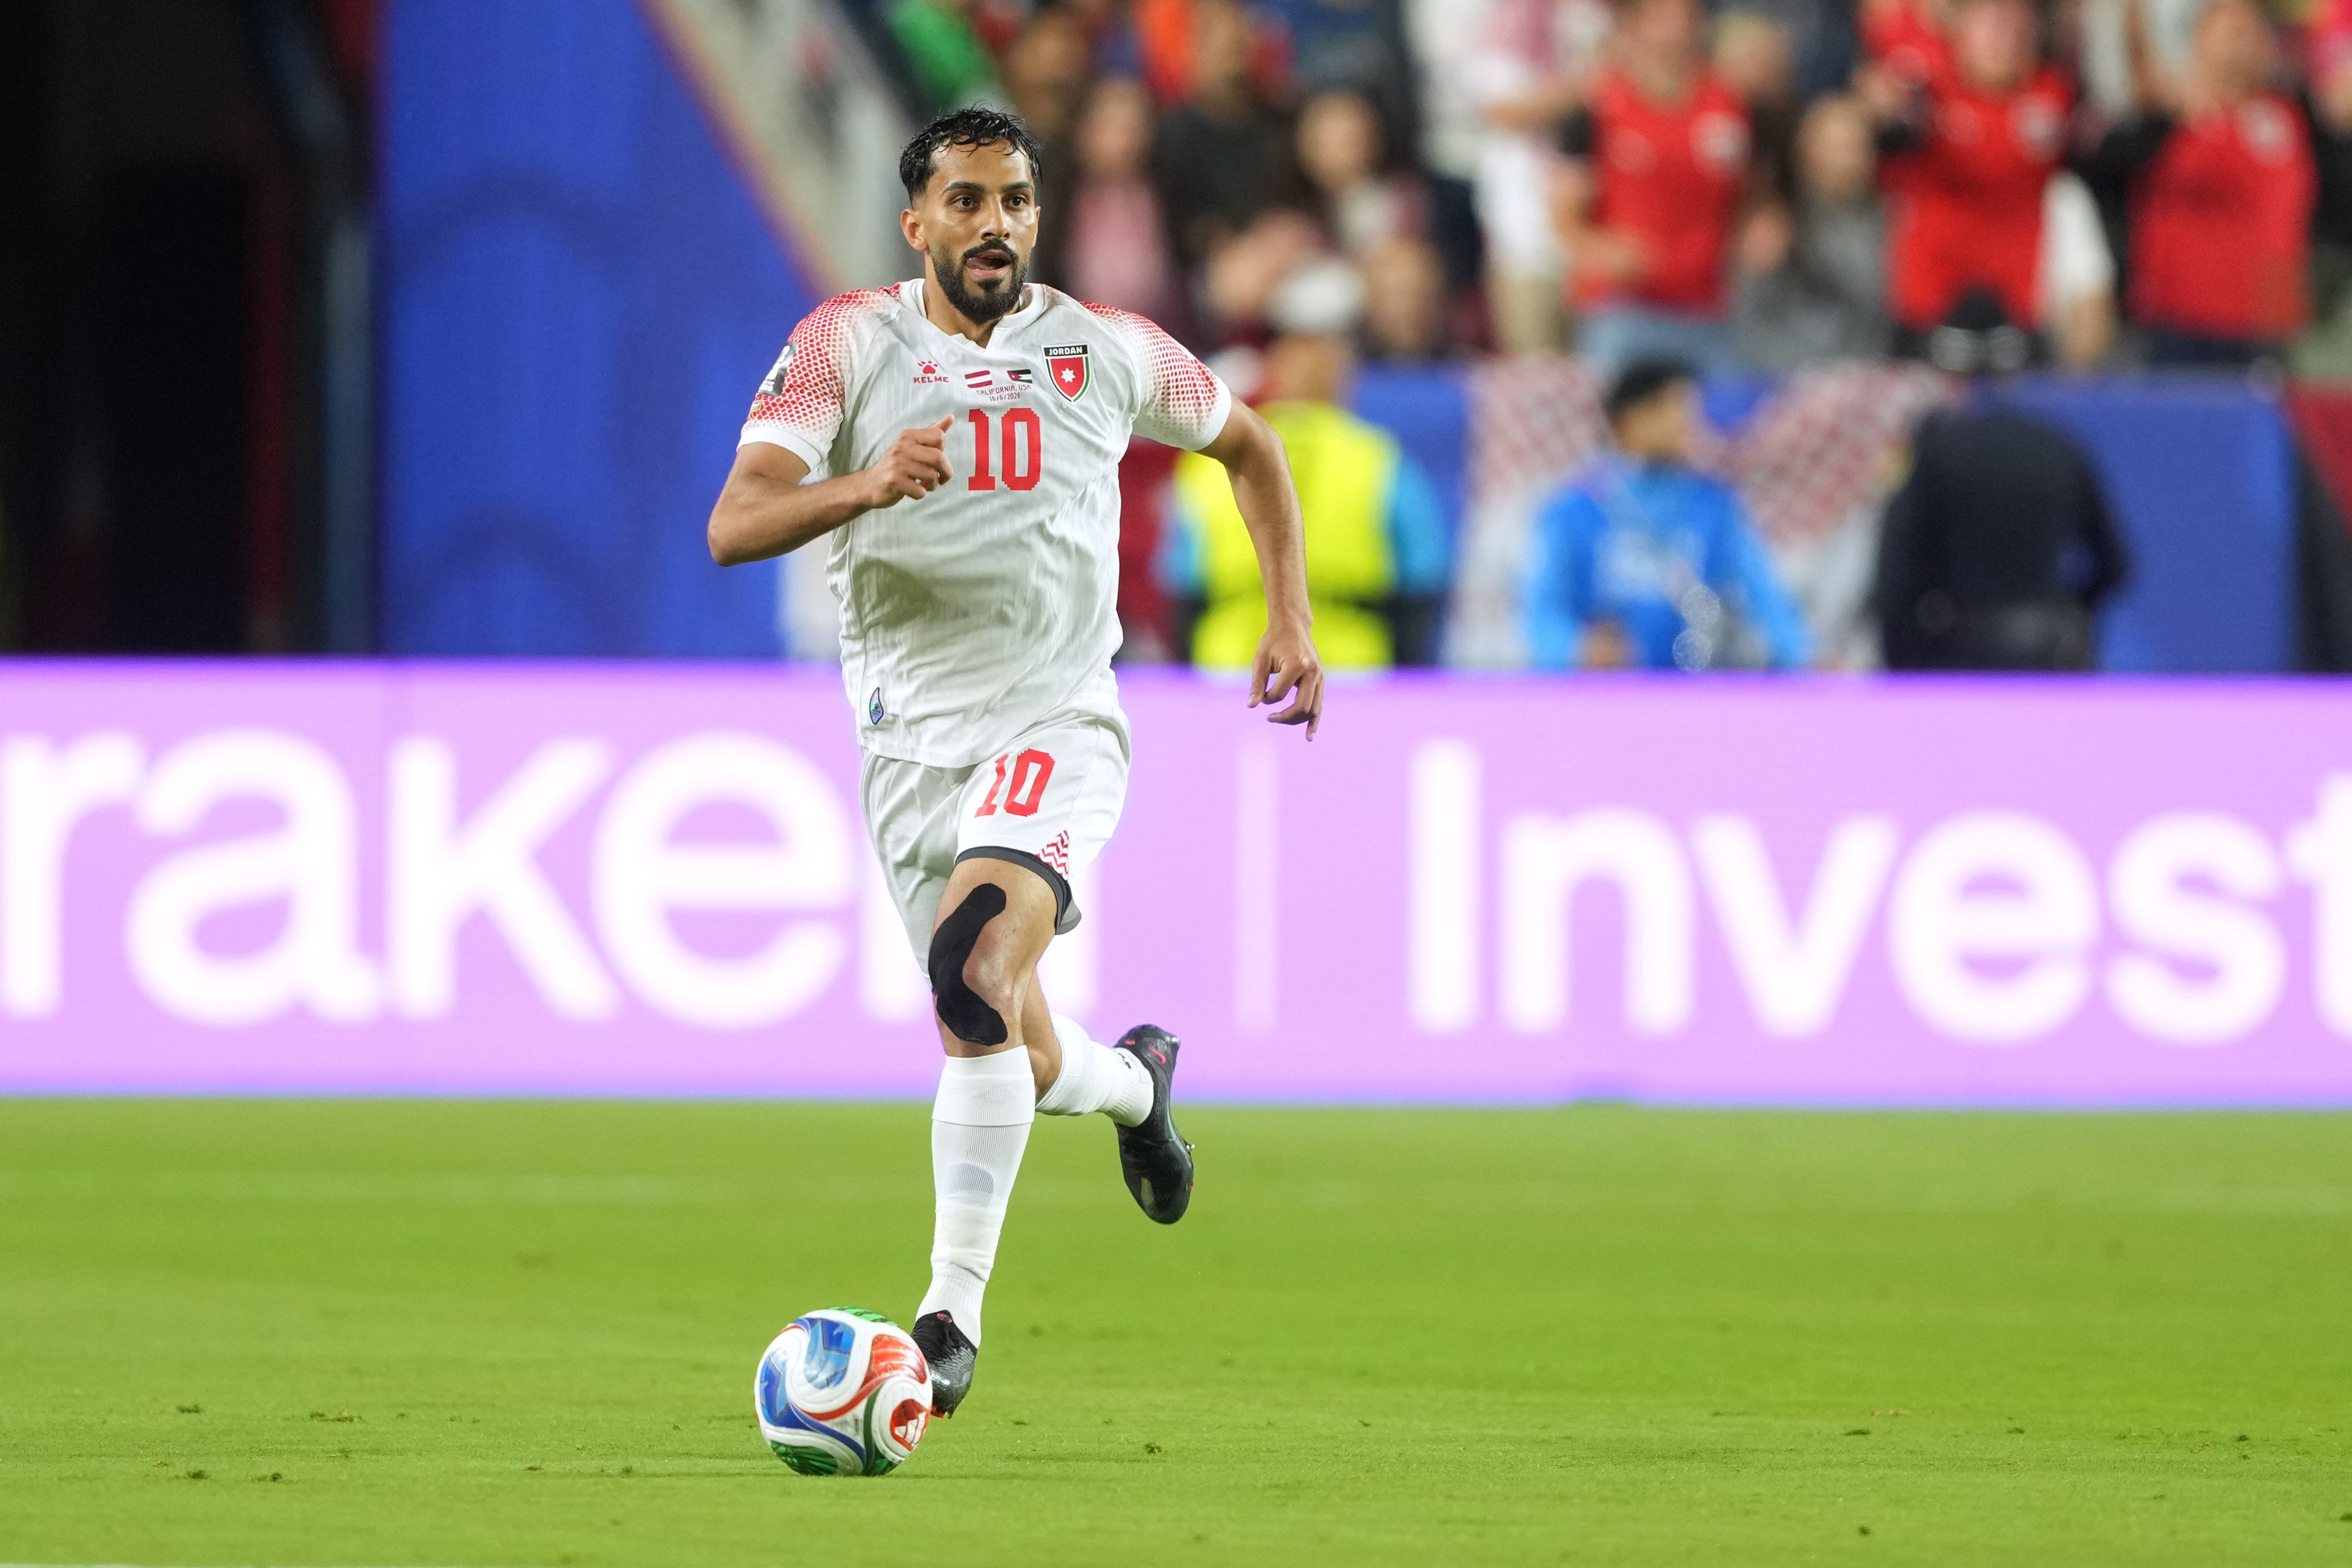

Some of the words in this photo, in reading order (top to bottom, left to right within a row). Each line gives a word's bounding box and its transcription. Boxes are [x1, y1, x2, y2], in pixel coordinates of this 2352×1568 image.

[1049, 346, 1083, 355] JORDAN
[976, 385, 1017, 395] CALIFORNIA,
[989, 393, 1021, 401] 16/6/2026
[968, 408, 1041, 490] 10
[974, 748, 1055, 818] 10
